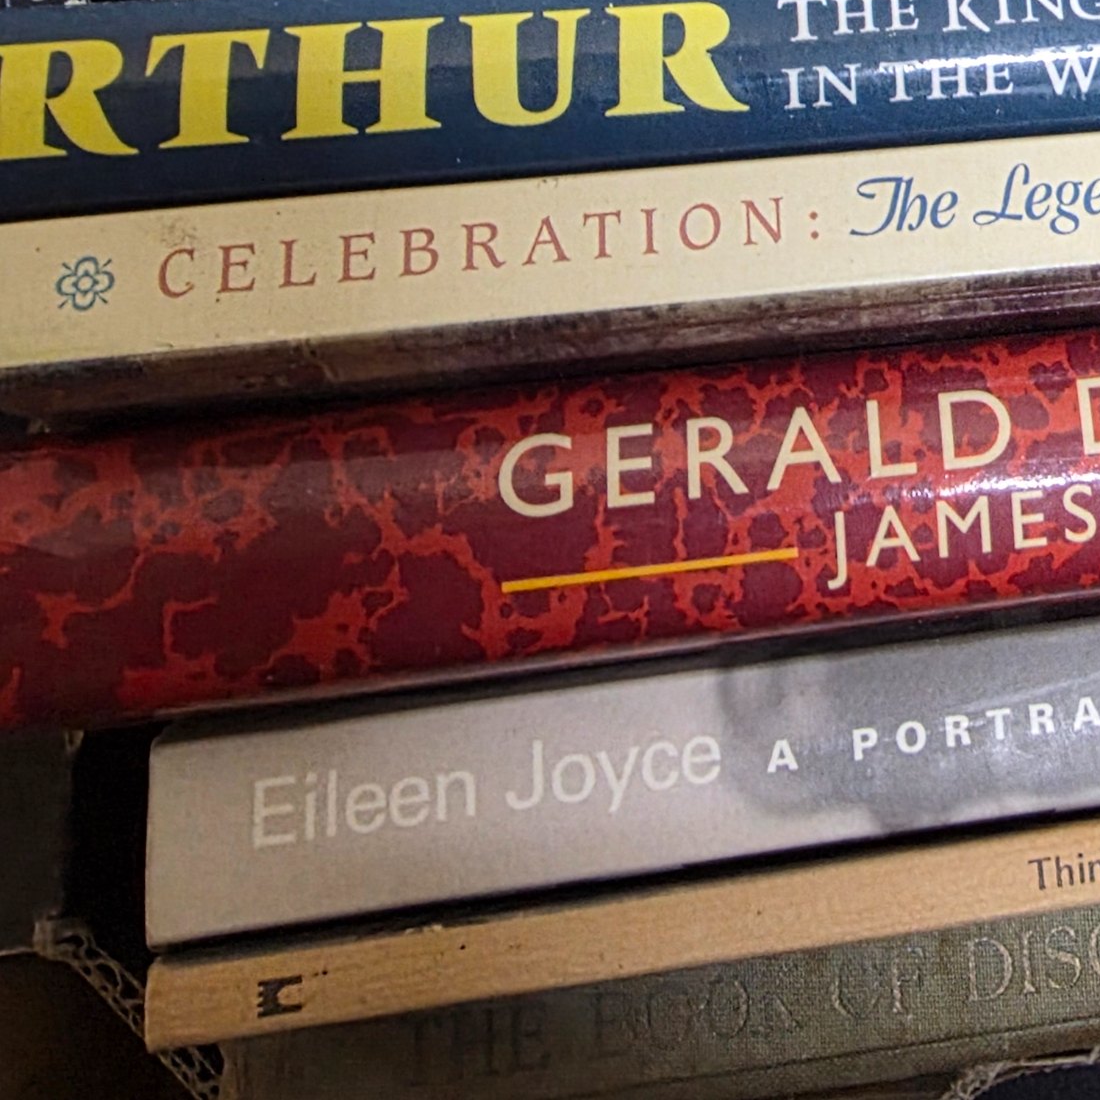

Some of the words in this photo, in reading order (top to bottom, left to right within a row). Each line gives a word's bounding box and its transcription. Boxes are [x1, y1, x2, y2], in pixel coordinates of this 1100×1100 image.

[782, 62, 863, 110] IN
[880, 57, 1014, 103] THE
[156, 194, 823, 300] CELEBRATION:
[849, 175, 959, 238] The
[498, 388, 1014, 519] GERALD
[827, 483, 1099, 591] JAMES
[251, 768, 478, 850] Eileen
[504, 734, 723, 814] Joyce
[766, 738, 800, 774] A
